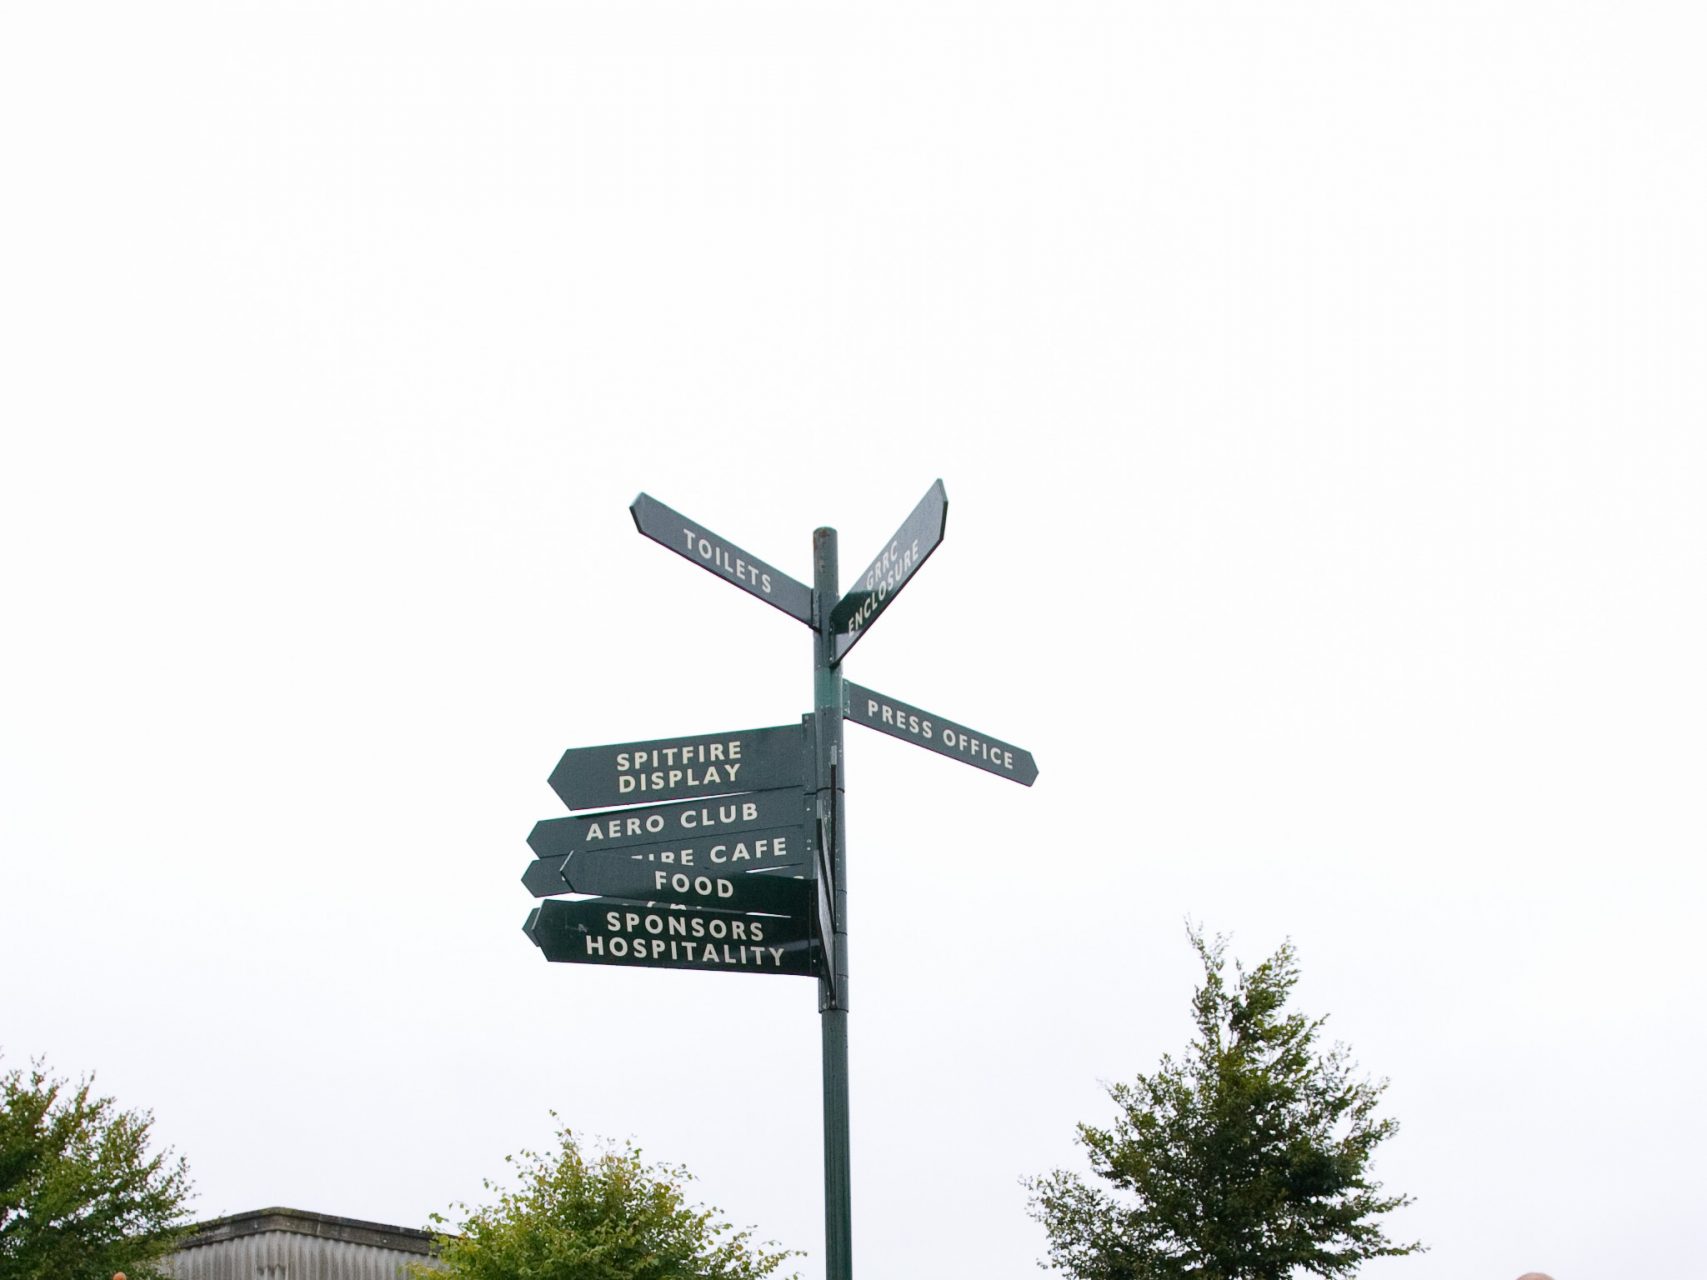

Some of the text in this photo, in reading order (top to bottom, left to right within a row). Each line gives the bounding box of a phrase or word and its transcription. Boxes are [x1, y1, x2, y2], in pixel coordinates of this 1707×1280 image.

[683, 528, 772, 594] TOILETS
[866, 541, 898, 590] GRRC
[848, 540, 919, 637] ENCLOSURE
[867, 699, 1014, 770] PRESS OFFICE
[616, 741, 742, 772] SPITFIRE
[618, 763, 741, 793] DISPLAY
[585, 803, 759, 842] AERO CLUB
[710, 837, 787, 863] CAFE
[655, 870, 734, 898] FOOD
[606, 912, 764, 941] SPONSORS
[585, 935, 785, 967] HOSPITALITY
